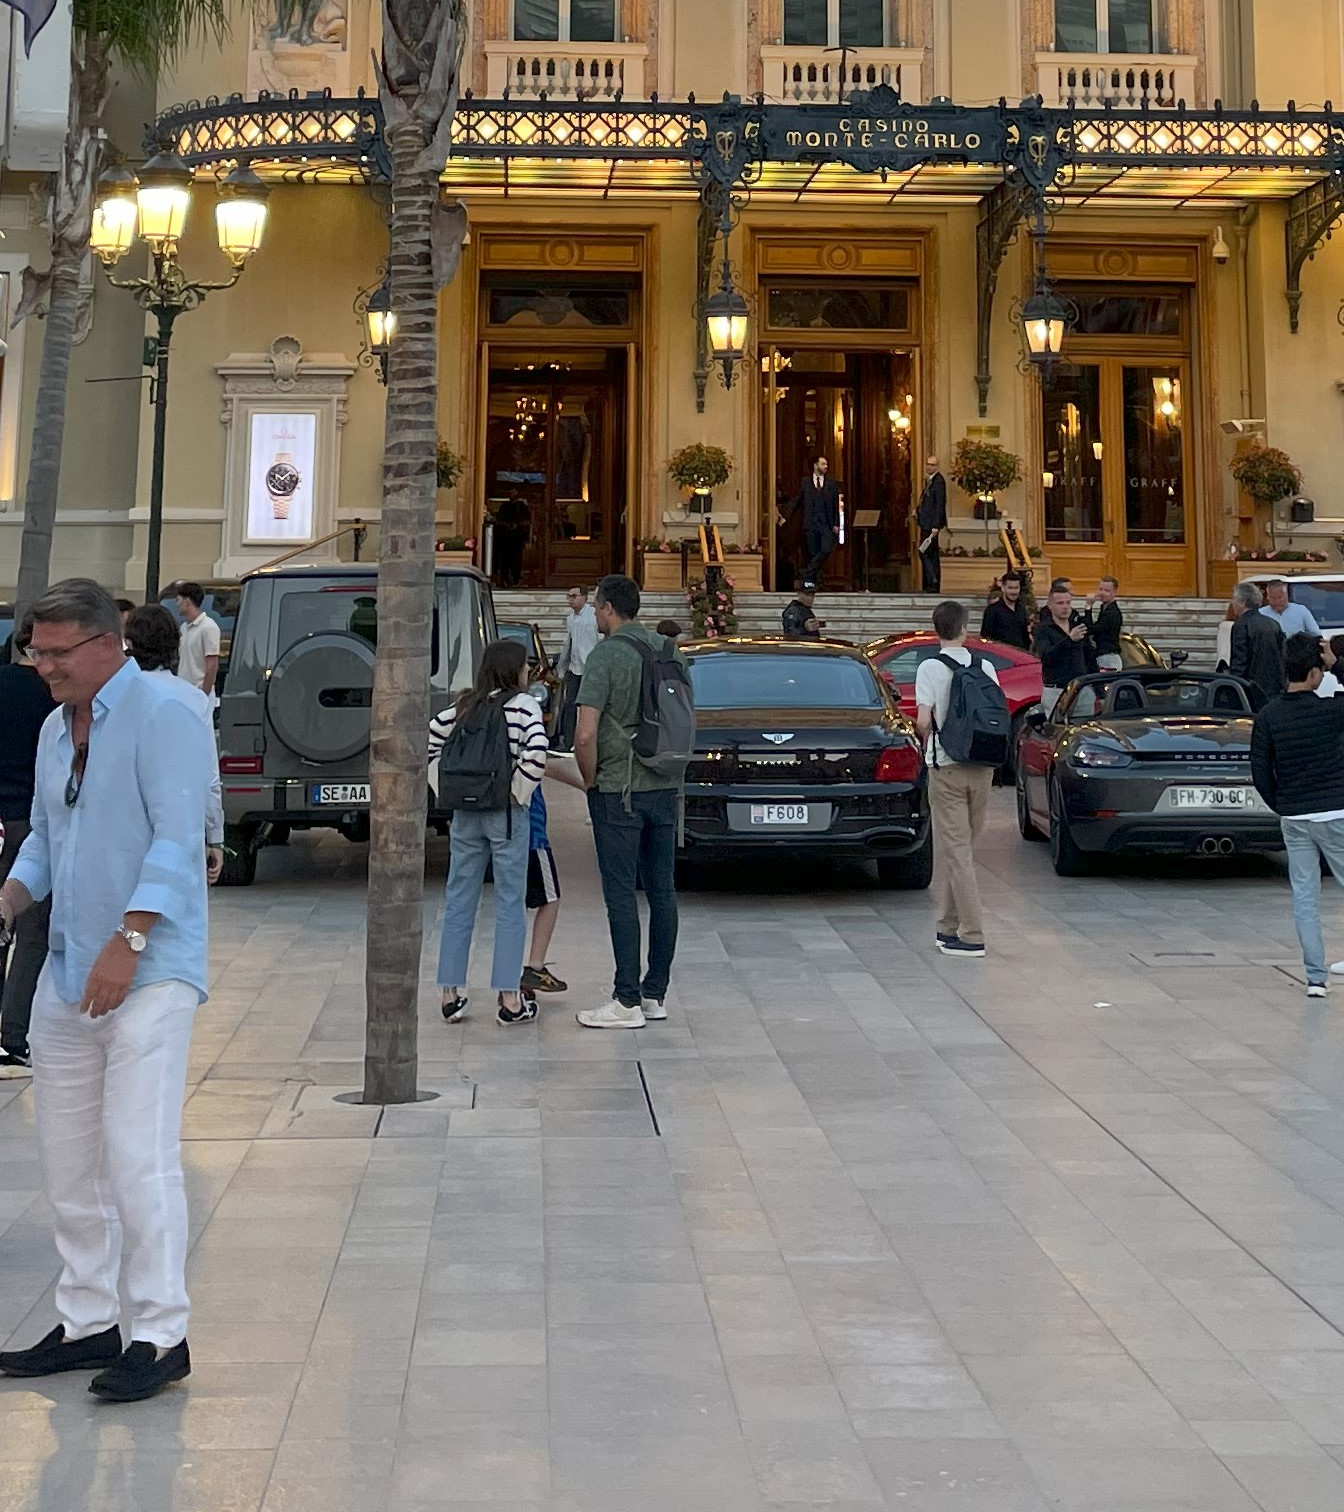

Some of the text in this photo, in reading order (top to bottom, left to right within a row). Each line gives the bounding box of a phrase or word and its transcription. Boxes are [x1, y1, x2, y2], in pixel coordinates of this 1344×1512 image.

[839, 119, 929, 132] CASINO
[1130, 478, 1177, 487] GRAFF
[767, 806, 805, 819] F608
